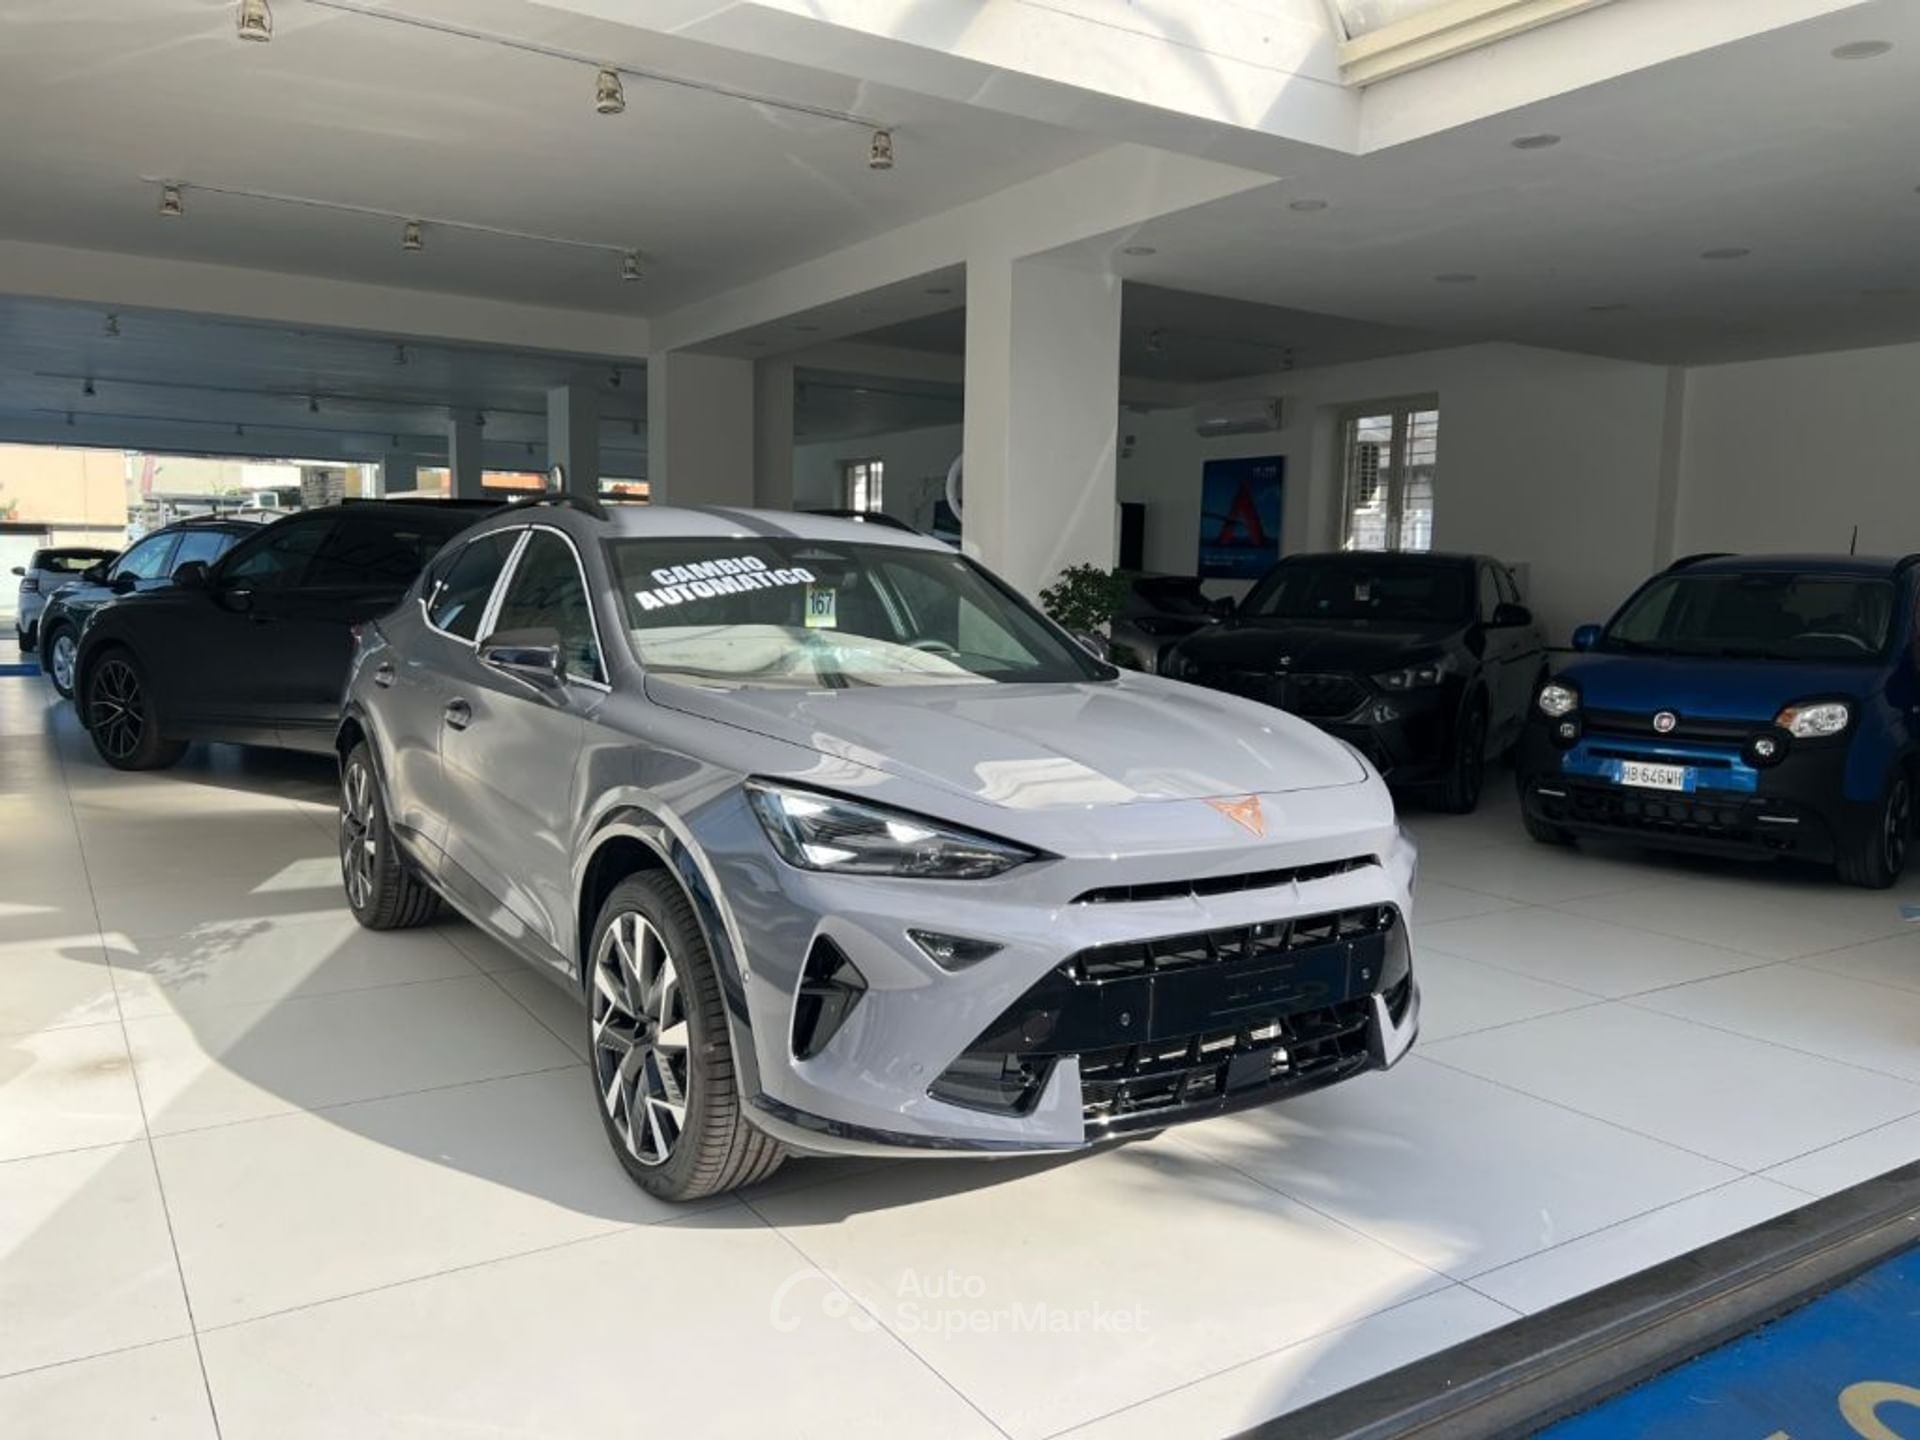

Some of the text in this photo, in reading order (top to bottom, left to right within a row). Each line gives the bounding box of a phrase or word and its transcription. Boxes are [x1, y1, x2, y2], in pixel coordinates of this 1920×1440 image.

[651, 556, 767, 585] CAMBIO
[635, 567, 816, 610] AUTOMATICO
[810, 592, 833, 615] 167
